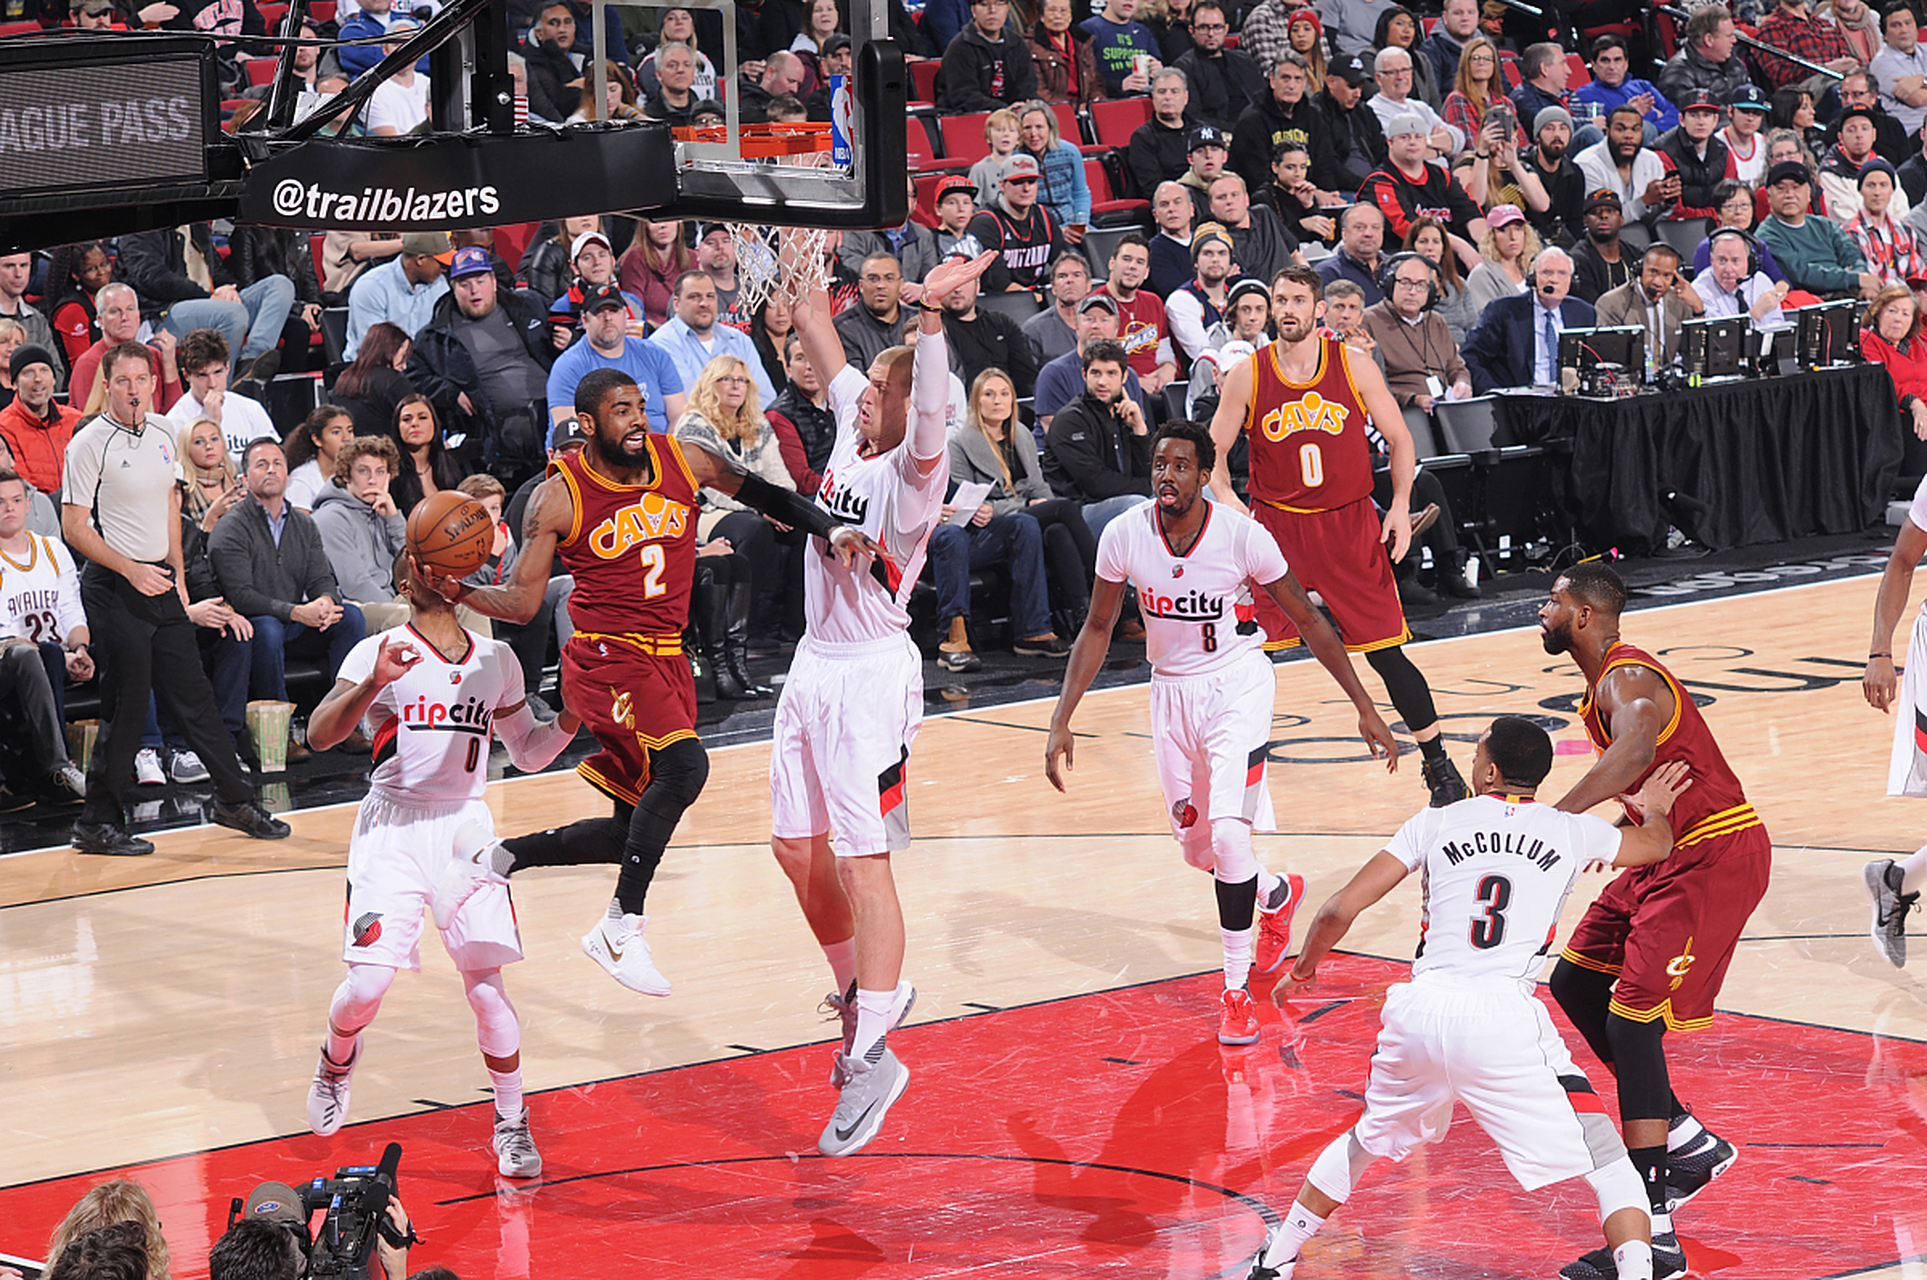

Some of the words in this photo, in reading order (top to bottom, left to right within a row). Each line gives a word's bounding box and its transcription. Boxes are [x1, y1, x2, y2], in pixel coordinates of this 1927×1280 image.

[101, 96, 191, 146] PASS
[273, 178, 500, 222] @trailblazers
[568, 421, 579, 436] P
[1262, 390, 1350, 443] CAVS
[1300, 442, 1324, 488] 0
[589, 491, 691, 560] CAVS
[641, 543, 667, 600] 2
[24, 610, 63, 645] 23
[1201, 622, 1218, 653] 8
[403, 694, 493, 736] ripcity
[465, 736, 480, 773] 0
[1441, 831, 1562, 873] McCOLLUM
[1470, 874, 1513, 951] 3
